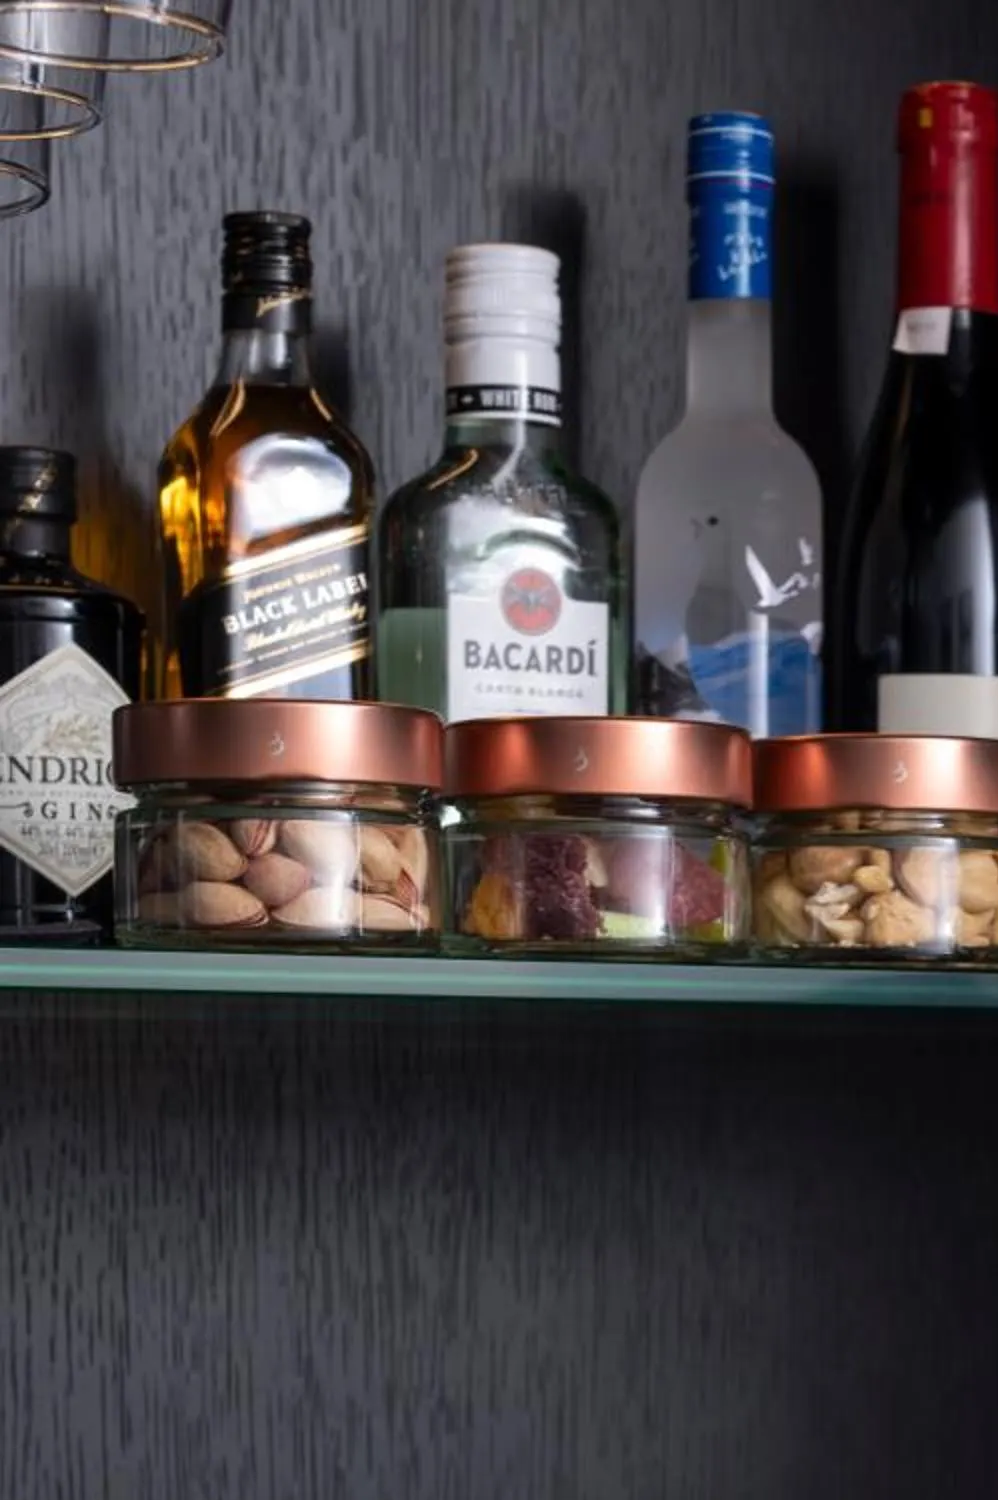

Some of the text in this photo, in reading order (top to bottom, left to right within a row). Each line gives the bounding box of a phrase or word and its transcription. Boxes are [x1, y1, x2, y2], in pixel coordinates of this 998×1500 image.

[222, 594, 299, 635] BLACK
[464, 638, 597, 677] BACARDÍ
[41, 801, 103, 821] GIN
